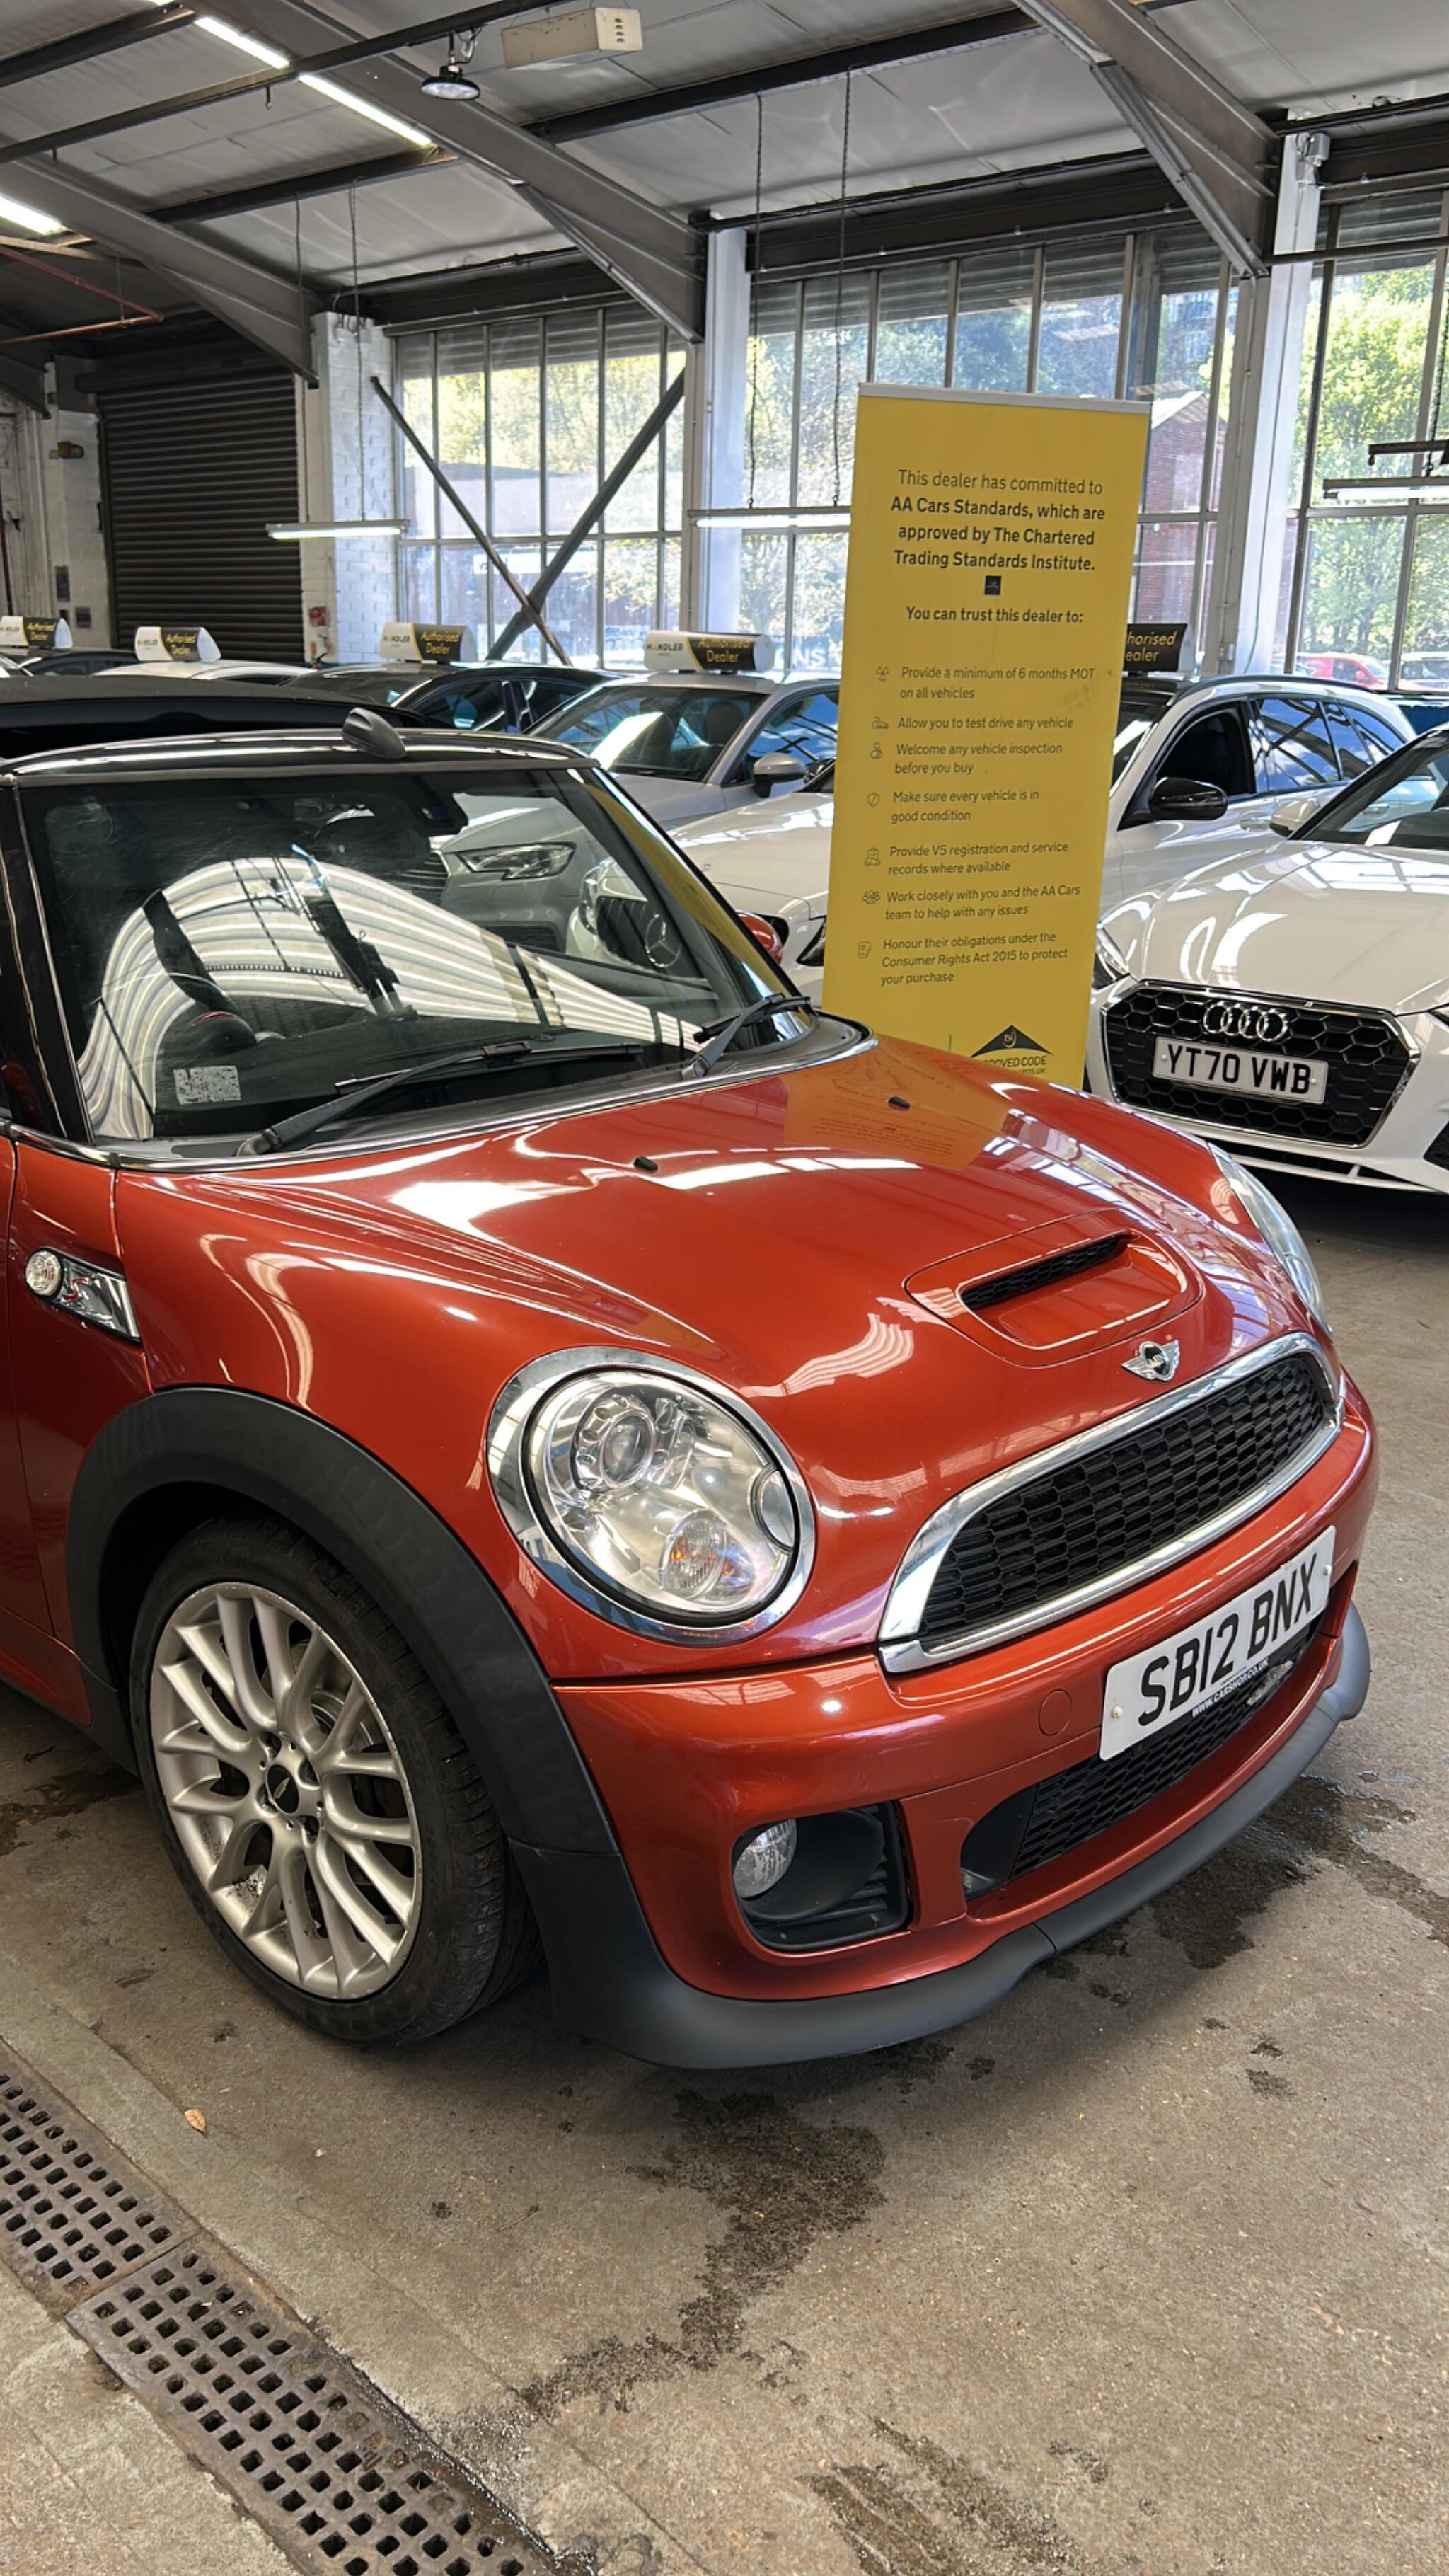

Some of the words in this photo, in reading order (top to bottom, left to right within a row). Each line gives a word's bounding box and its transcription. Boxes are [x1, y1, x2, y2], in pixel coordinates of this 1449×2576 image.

[899, 469, 928, 485] This
[933, 471, 978, 488] dealer
[981, 474, 1006, 490] has
[1010, 478, 1085, 493] committed
[1090, 480, 1102, 494] to
[891, 497, 913, 511] AA
[917, 498, 949, 513] Cars
[954, 500, 1033, 518] Standards,
[1038, 504, 1079, 519] which
[1083, 509, 1104, 519] are
[899, 527, 968, 541] approved
[972, 527, 991, 544] by
[993, 528, 1020, 542] The
[1024, 529, 1095, 545] Chartered
[894, 550, 948, 568] Trading
[952, 551, 1027, 568] Standards
[1032, 555, 1095, 570] Institute.
[907, 606, 930, 620] You
[933, 610, 957, 620] can
[961, 608, 992, 621] trust
[996, 609, 1019, 621] this
[1022, 609, 1063, 622] dealer
[1066, 611, 1083, 623] to:
[1126, 629, 1178, 645] horised
[706, 650, 739, 663] Dealer
[1124, 645, 1160, 662] ealer
[901, 667, 942, 678] Provide
[944, 669, 950, 678] a
[954, 667, 1003, 679] minimum
[1006, 667, 1017, 679] of
[1018, 667, 1026, 679] 6
[1029, 668, 1067, 679] months
[1070, 668, 1095, 679] MOT
[900, 689, 913, 698] on
[916, 688, 928, 698] all
[931, 688, 975, 698] vehicles
[898, 718, 928, 728] Allow
[930, 720, 949, 730] you
[952, 718, 963, 728] to
[966, 718, 986, 728] test
[988, 718, 1015, 728] drive
[1017, 719, 1035, 730] any
[1037, 717, 1073, 728] vehicle
[897, 744, 946, 754] Welcome
[949, 746, 968, 756] any
[971, 743, 1007, 754] vehicle
[1009, 743, 1062, 755] inspection
[895, 762, 929, 774] before
[931, 764, 950, 776] you
[954, 762, 974, 775] buy
[893, 791, 921, 803] Make
[924, 793, 947, 802] sure
[949, 793, 979, 803] every
[981, 790, 1017, 800] vehicle
[1019, 790, 1027, 800] is
[1030, 789, 1039, 799] in
[891, 811, 918, 824] good
[920, 810, 971, 821] condition
[890, 846, 930, 856] Provide
[933, 845, 947, 855] V5
[949, 844, 1008, 856] registration
[1010, 842, 1029, 853] and
[1032, 842, 1068, 852] service
[889, 863, 928, 875] records
[931, 863, 964, 873] where
[966, 861, 1010, 873] available
[887, 891, 914, 902] Work
[917, 890, 954, 902] closely
[957, 890, 978, 899] with
[981, 890, 999, 900] you
[1001, 887, 1020, 897] and
[1023, 887, 1039, 897] the
[1040, 885, 1056, 896] AA
[1058, 885, 1080, 895] Cars
[886, 910, 911, 920] team
[914, 909, 925, 919] to
[928, 907, 950, 919] help
[953, 907, 975, 917] with
[978, 908, 995, 918] any
[998, 905, 1028, 915] issues
[883, 940, 923, 950] Honour
[925, 937, 949, 948] their
[951, 936, 1006, 948] obligations
[1009, 933, 1038, 944] under
[1040, 933, 1056, 943] the
[882, 957, 935, 967] Consumer
[938, 954, 971, 966] Rights
[973, 953, 990, 962] Act
[992, 950, 1017, 961] 2015
[1019, 950, 1029, 960] to
[1032, 948, 1067, 961] protect
[881, 975, 904, 987] your
[906, 972, 954, 984] purchase
[1021, 1056, 1047, 1066] CODE
[1167, 1044, 1240, 1083] YT70
[1252, 1057, 1312, 1095] VWB
[1138, 1613, 1239, 1727] SB12
[1247, 1553, 1317, 1659] BNX
